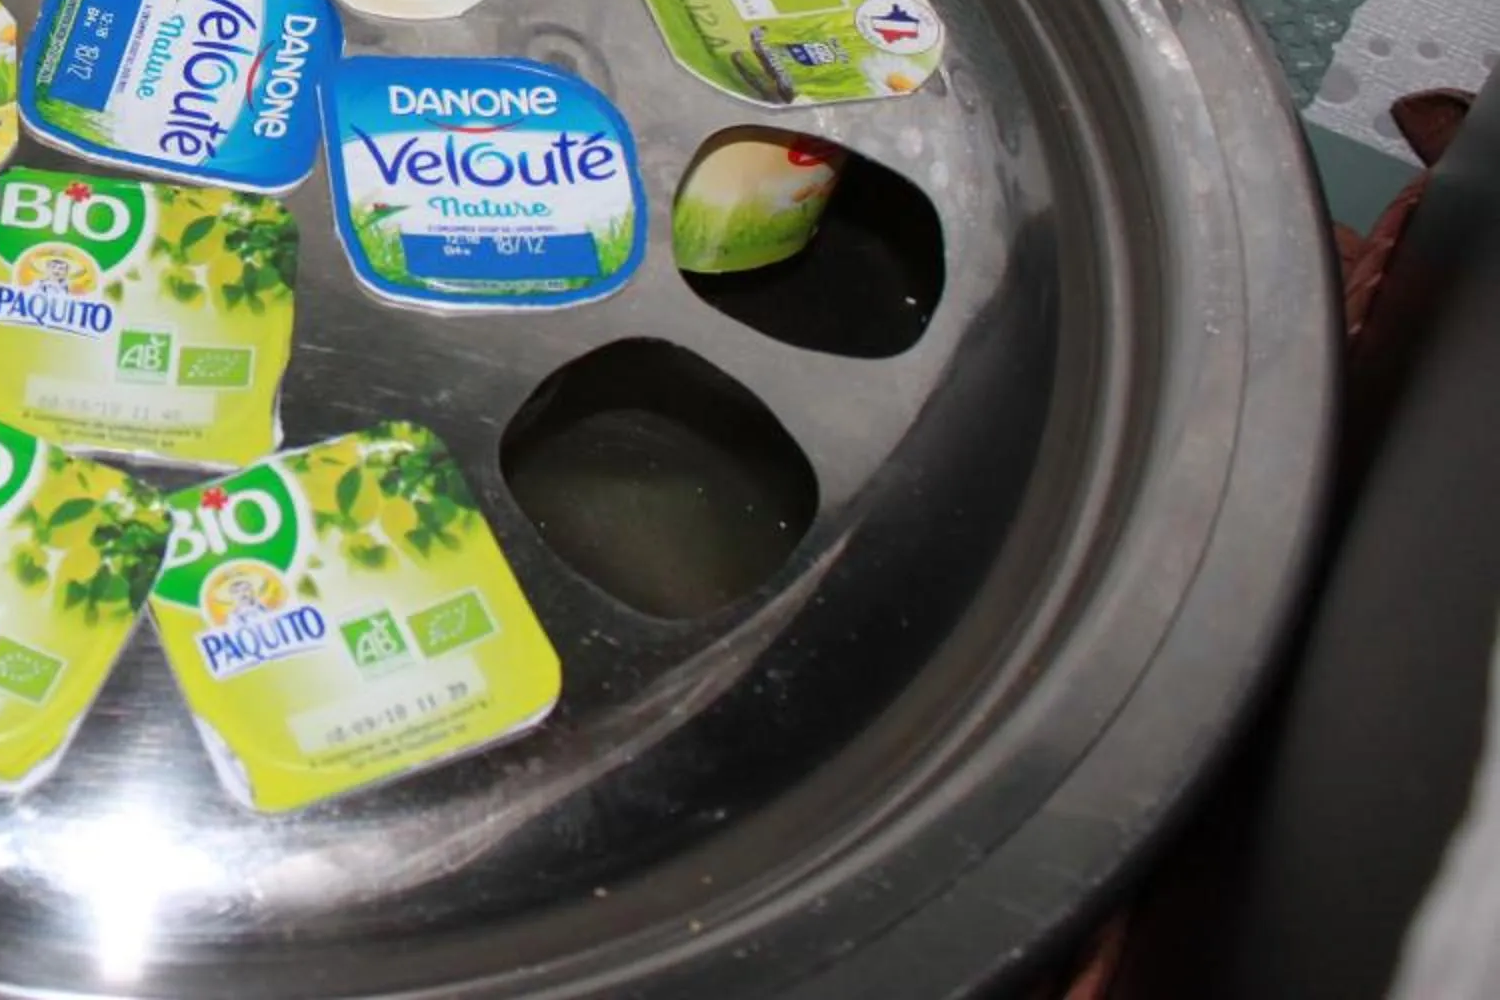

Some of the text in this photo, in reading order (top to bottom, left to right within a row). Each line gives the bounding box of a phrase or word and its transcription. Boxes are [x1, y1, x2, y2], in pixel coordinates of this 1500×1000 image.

[136, 13, 187, 101] Nature
[350, 123, 618, 187] Velouté
[427, 195, 553, 218] Nature
[202, 604, 327, 673] PAQUITO
